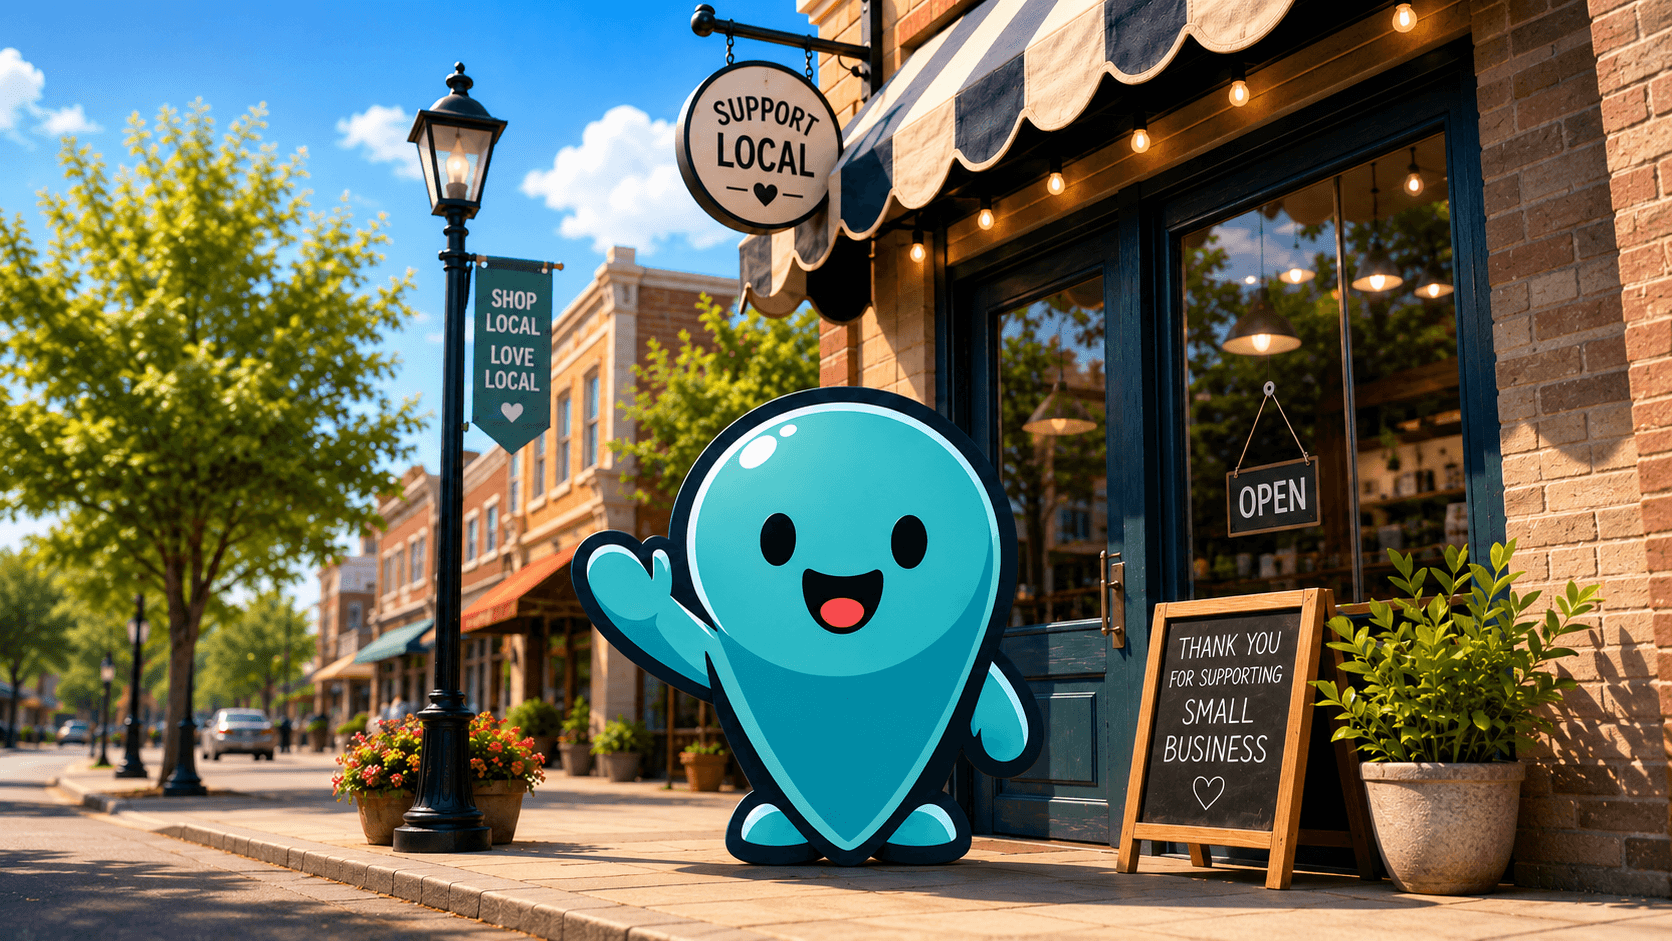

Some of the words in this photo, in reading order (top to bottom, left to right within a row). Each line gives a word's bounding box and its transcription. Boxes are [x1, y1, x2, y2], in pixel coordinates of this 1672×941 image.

[713, 95, 820, 137] SUPPORT
[717, 132, 815, 178] LOCAL
[491, 288, 537, 310] SHOP
[486, 313, 540, 336] LOCAL
[490, 344, 534, 367] LOVE
[485, 369, 540, 392] LOCAL
[1239, 476, 1306, 519] OPEN
[1179, 633, 1239, 660] THANK
[1246, 630, 1282, 656] YOU
[1169, 669, 1195, 688] FOR
[1198, 665, 1283, 687] SUPPORTING
[1182, 697, 1254, 726] SMALL
[1163, 735, 1268, 763] BUSINESS
